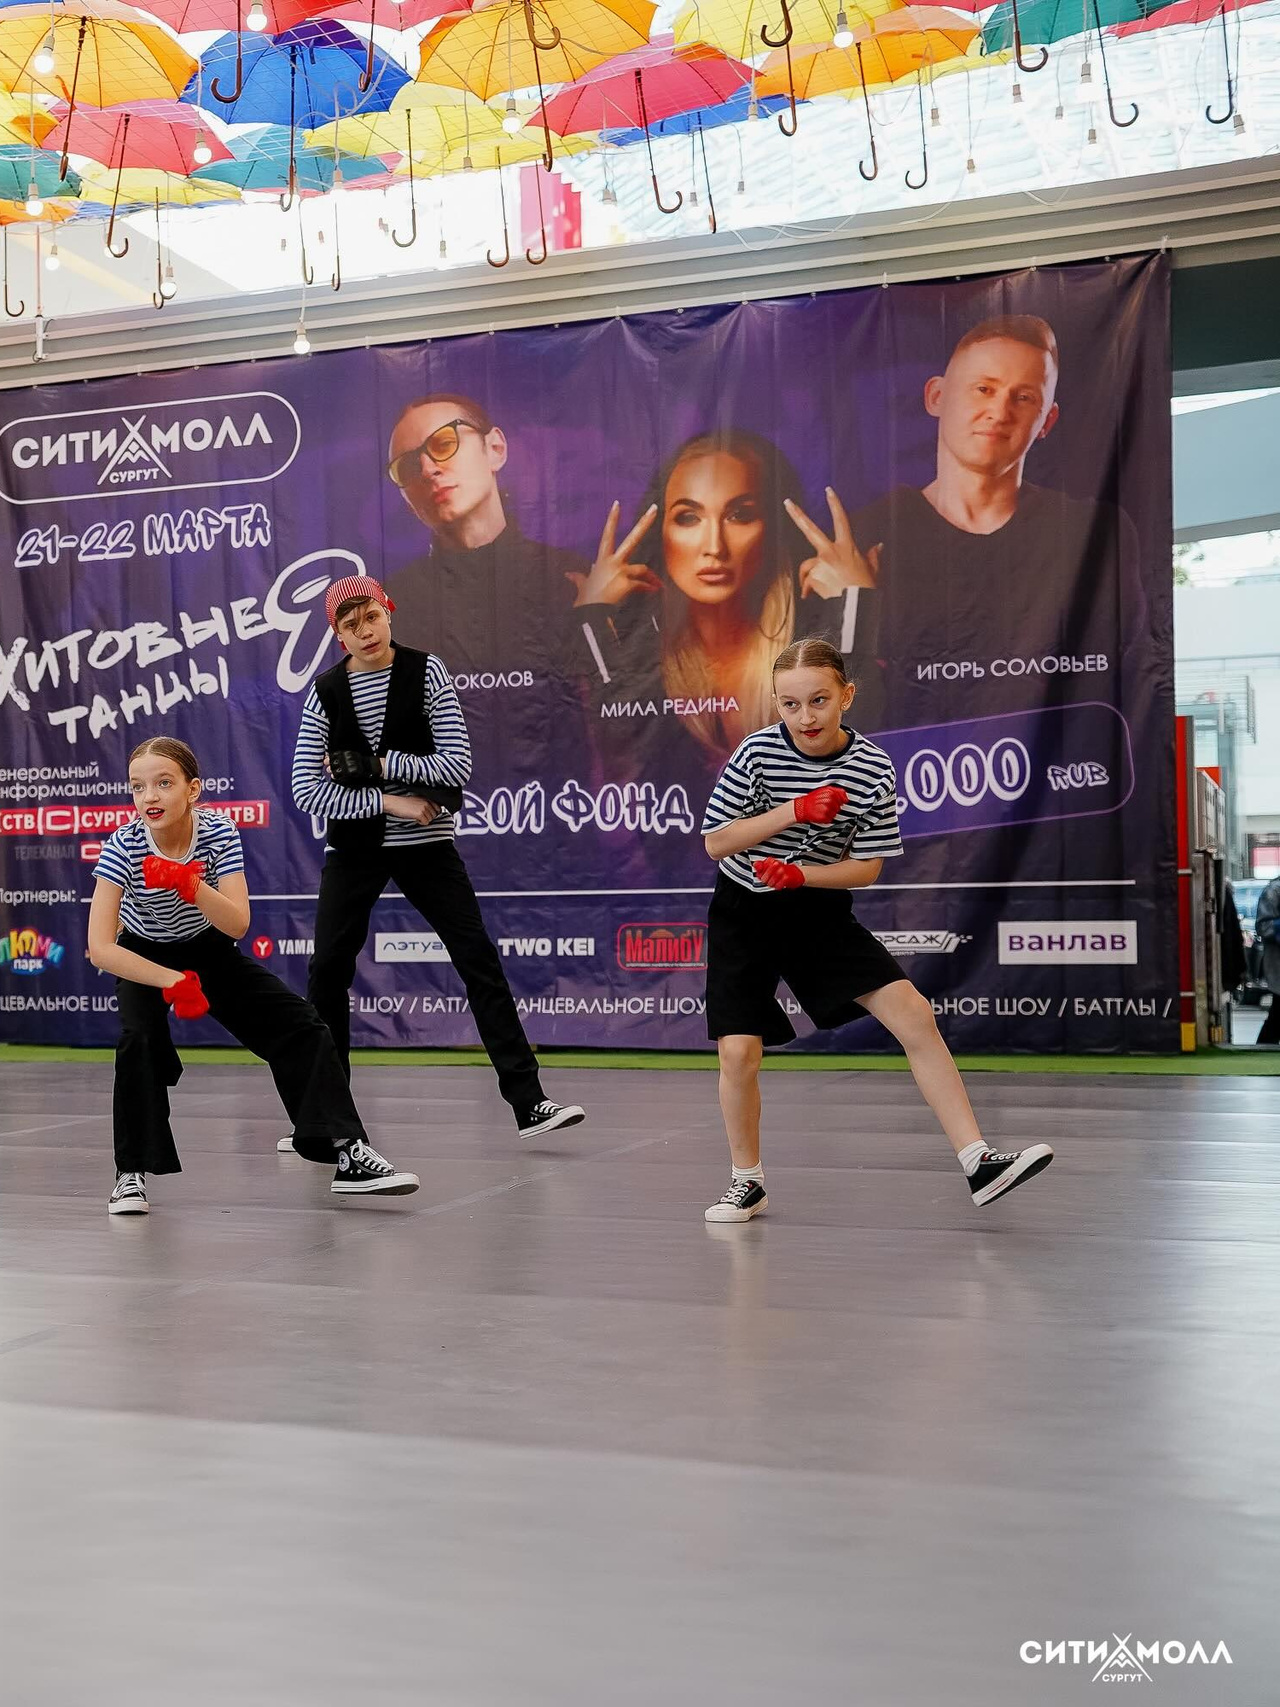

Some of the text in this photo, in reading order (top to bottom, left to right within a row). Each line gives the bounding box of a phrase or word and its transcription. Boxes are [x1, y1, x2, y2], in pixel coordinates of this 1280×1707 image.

[109, 467, 160, 484] СУРГУТ
[14, 502, 272, 568] 21-22 МАРТА
[917, 653, 1110, 681] ИГОРЬ СОЛОВЬЕВ
[601, 696, 740, 718] МИЛА РЕДИНА
[1047, 761, 1110, 792] RUB
[277, 939, 315, 955] YAMA
[497, 937, 595, 956] TWO KEI
[875, 934, 942, 945] РСАЖ
[1008, 934, 1128, 952] ванлав
[13, 957, 43, 971] парк
[92, 994, 119, 1012] ШО
[359, 996, 404, 1014] ШОУ
[512, 996, 707, 1015] АНЦЕВАЛЬНОЕ ШОУ
[995, 997, 1052, 1016] ШОУ
